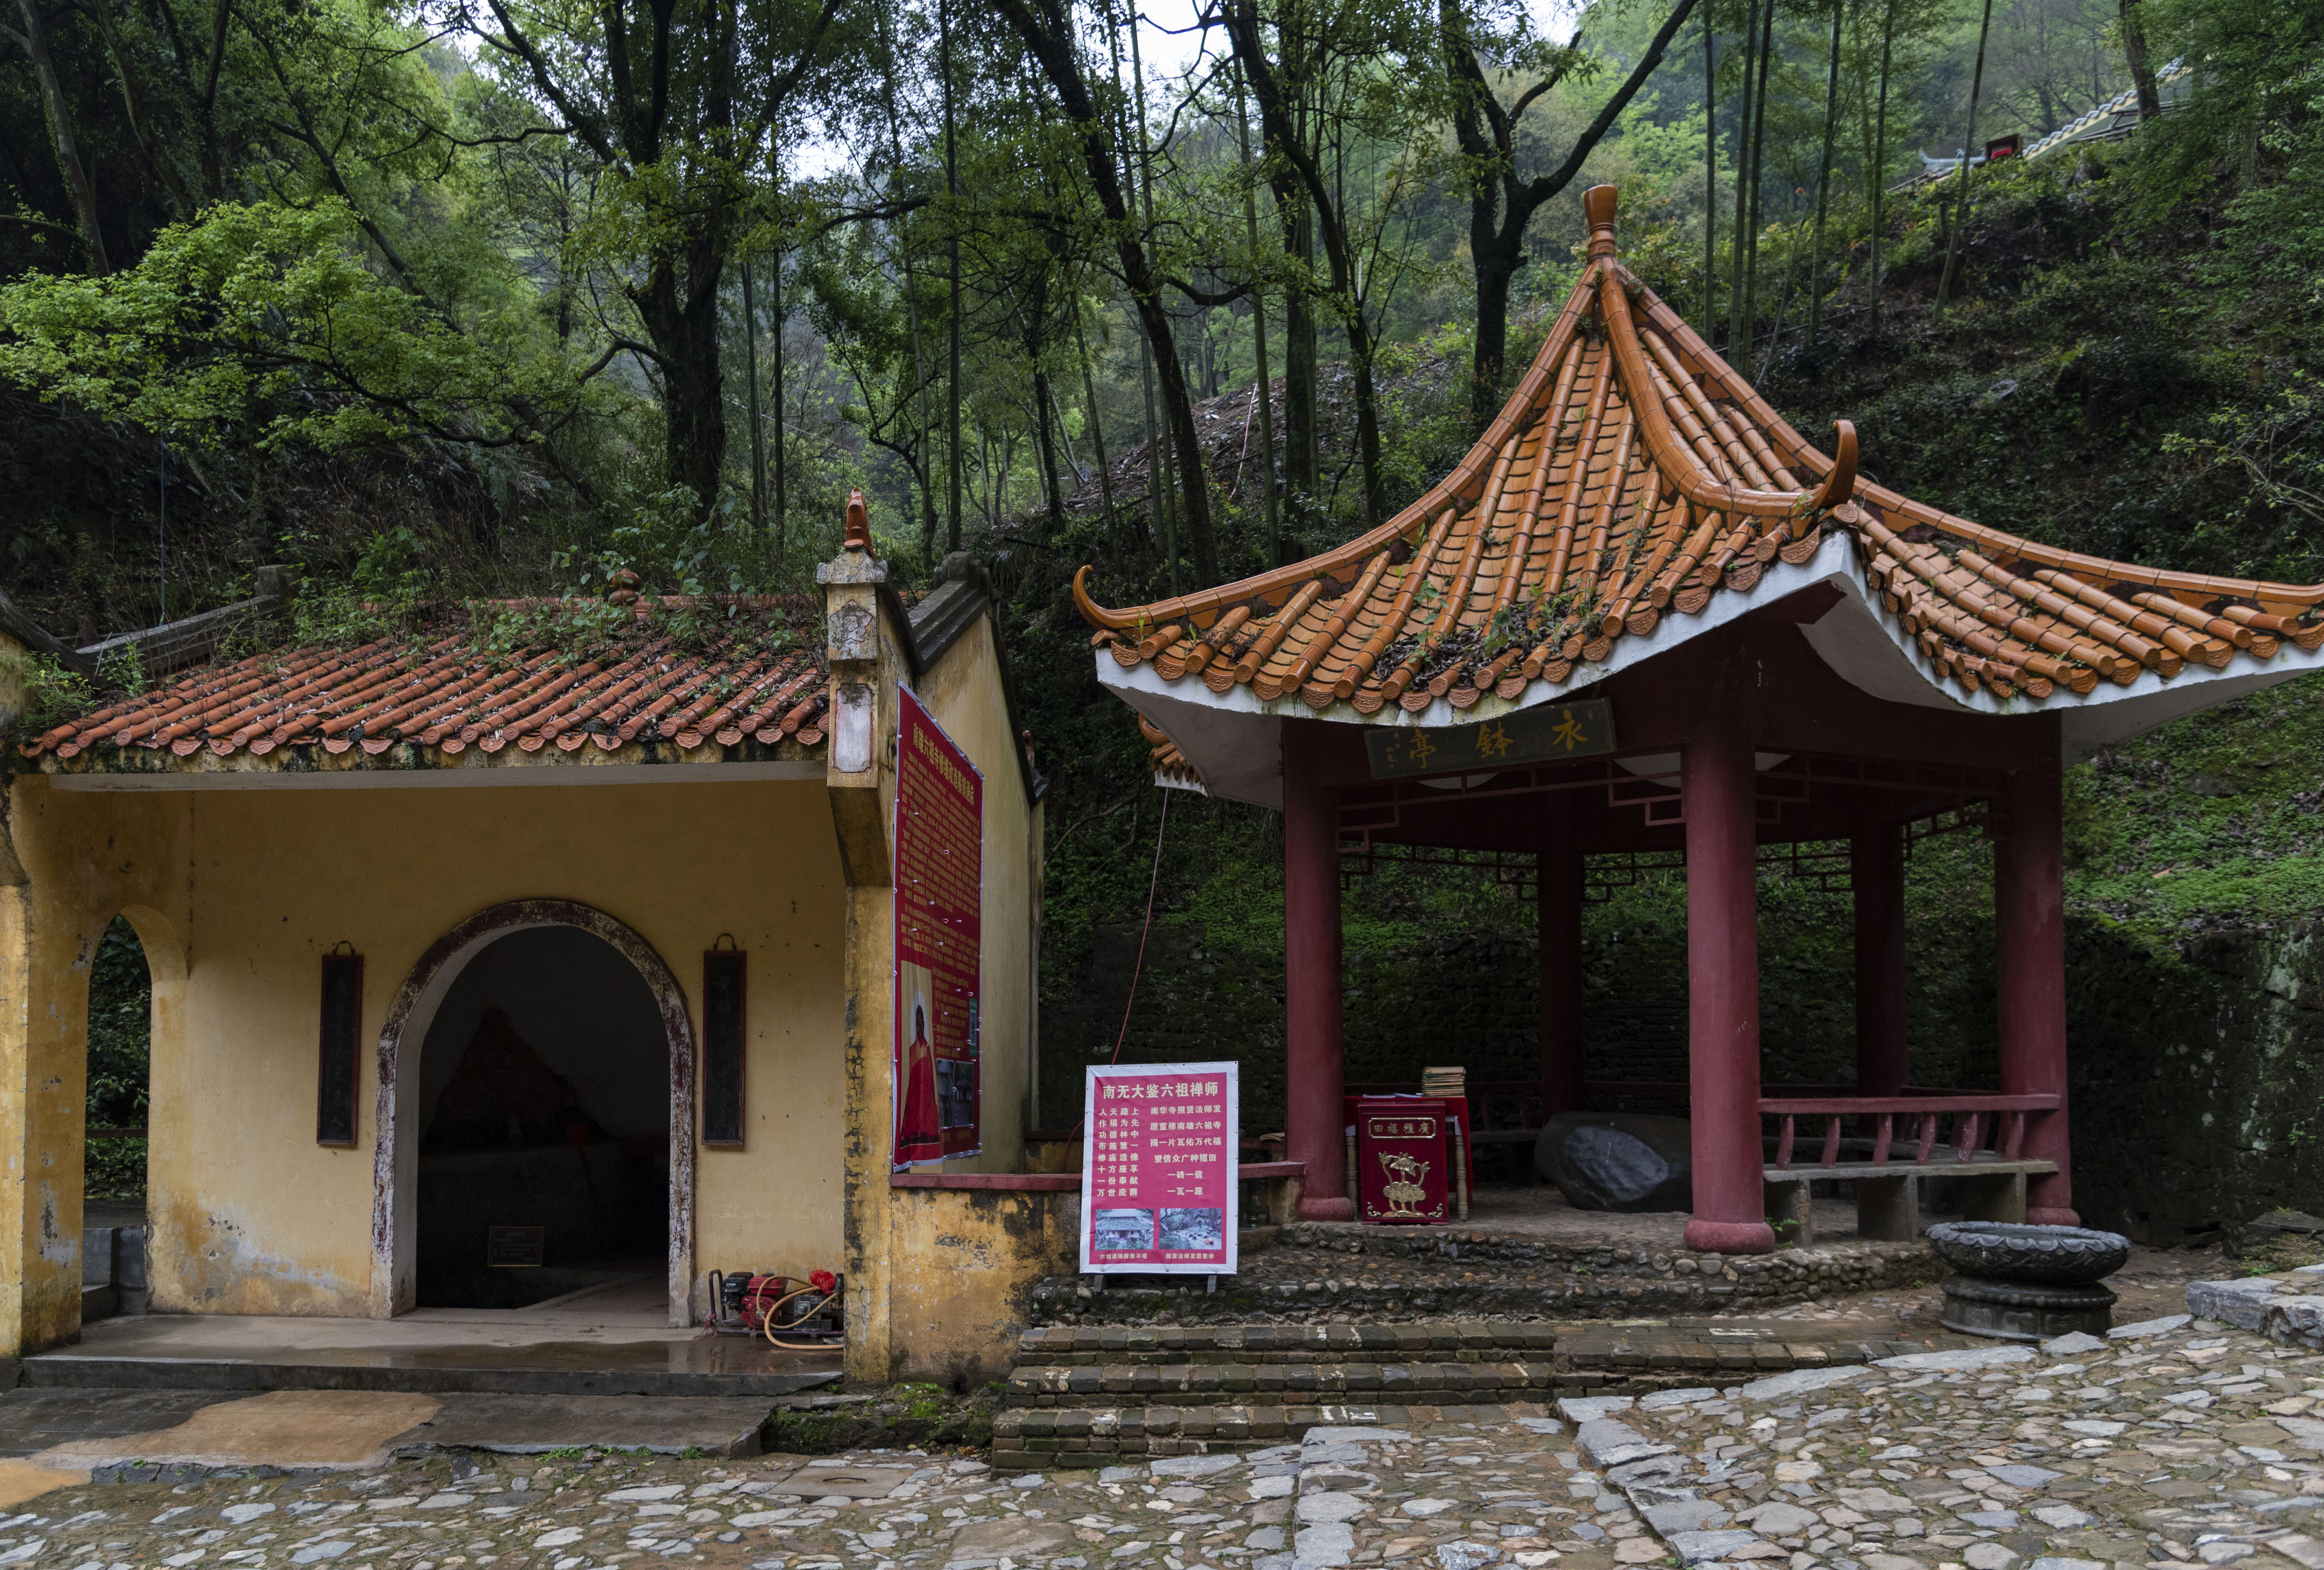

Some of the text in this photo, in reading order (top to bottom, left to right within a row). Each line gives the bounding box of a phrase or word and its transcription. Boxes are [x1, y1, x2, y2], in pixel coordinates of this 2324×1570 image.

[1103, 1082, 1218, 1099] 南无大鉴六祖禅师
[1151, 1105, 1221, 1115] 南华寺照贤法师发
[1099, 1118, 1139, 1127] 作福为先
[1150, 1121, 1221, 1130] 愿重修南雄六祖寺
[1374, 1122, 1429, 1134] 廣種福田
[1099, 1130, 1138, 1138] 功德林中
[1099, 1142, 1138, 1150] 布施第一
[1150, 1137, 1221, 1147] 捐一片瓦佑万代福
[1098, 1153, 1138, 1161] 修庙造佛
[1154, 1154, 1216, 1163] 望信众广种福田
[1098, 1165, 1138, 1173] 十方座享
[1167, 1170, 1203, 1179] 一砖一信
[1097, 1176, 1138, 1185] 一份奉献
[1097, 1188, 1137, 1197] 万世庇荫
